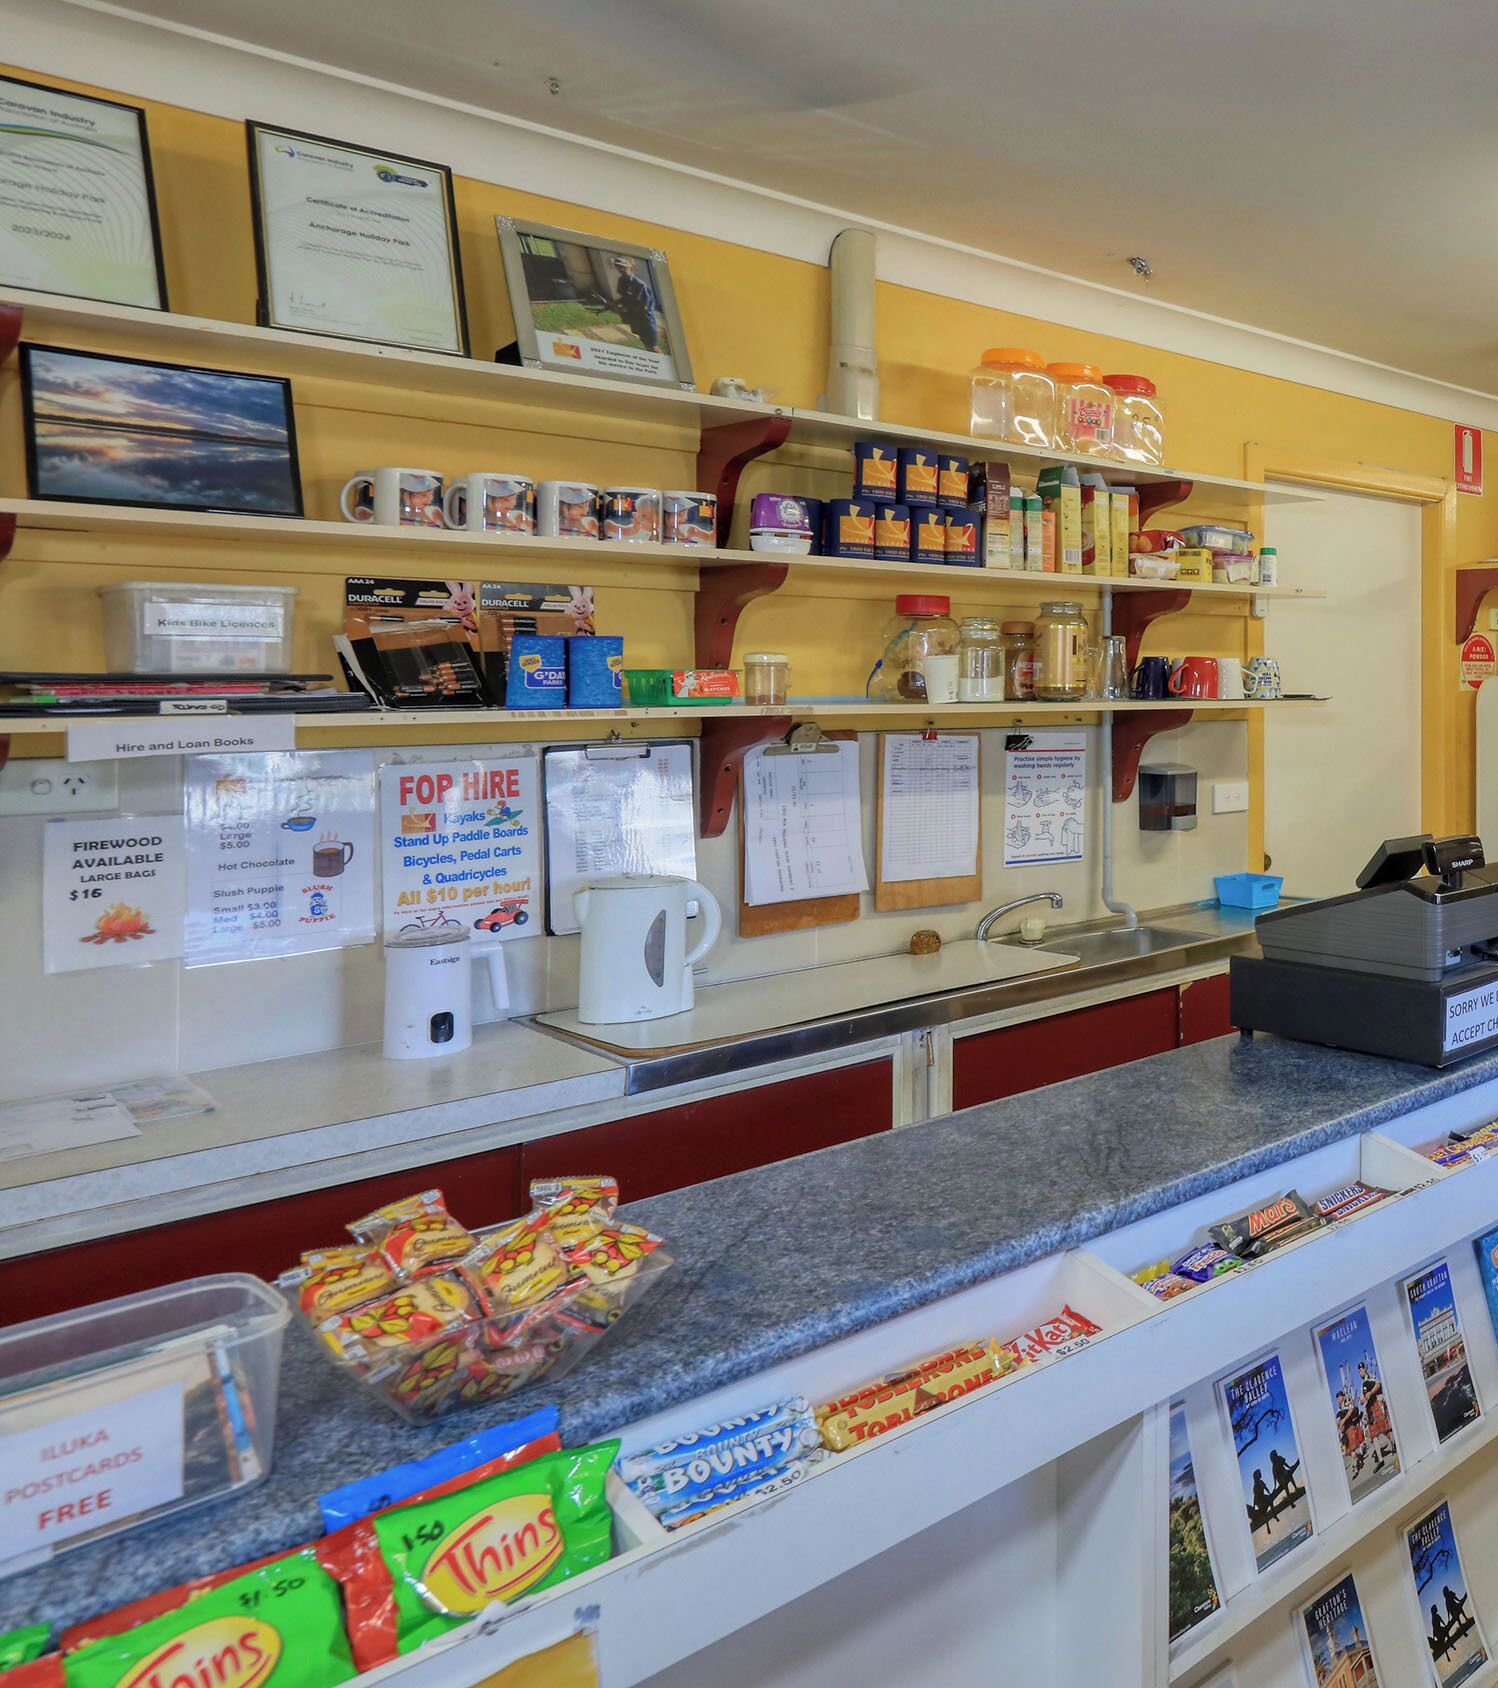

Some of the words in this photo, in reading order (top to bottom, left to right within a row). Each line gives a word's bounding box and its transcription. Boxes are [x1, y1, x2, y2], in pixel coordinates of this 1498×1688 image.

[50, 108, 96, 127] Industry
[306, 196, 348, 210] Certificate
[360, 207, 410, 223] Accreditation
[309, 221, 358, 238] Anchorage
[360, 231, 391, 244] Holiday
[393, 238, 411, 248] Park
[348, 593, 403, 604] DURACELL
[481, 598, 529, 608] DURACELL
[158, 619, 186, 628] Kids
[190, 619, 217, 628] Bike
[220, 620, 275, 629] Licences
[116, 743, 144, 752] Hire
[149, 740, 174, 750] and
[178, 739, 210, 749] Loan
[214, 737, 254, 747] Books
[1036, 755, 1053, 763] simple
[1054, 754, 1074, 763] hygiene
[1075, 754, 1081, 762] by
[463, 769, 520, 801] HIRE
[443, 811, 486, 826] Kayaks
[73, 836, 163, 852] FIREWOOD
[219, 841, 250, 850] $5.00
[394, 835, 429, 848] Stand
[433, 833, 449, 847] Up
[453, 830, 490, 843] Paddle
[493, 826, 529, 839] Boards
[72, 853, 164, 870] AVAILABLE
[218, 862, 238, 871] Hot
[241, 858, 296, 870] Chocolate
[403, 853, 457, 868] Bicycles,
[461, 849, 490, 861] Pedal
[494, 845, 522, 857] Carts
[1451, 858, 1474, 868] SHARP
[80, 872, 122, 883] LARGE
[124, 869, 156, 879] BAGS
[422, 873, 432, 885] &
[435, 866, 507, 884] Quadricycles
[213, 889, 245, 898] Slush
[247, 884, 284, 896] Puppie
[302, 884, 333, 893] SLUSH
[397, 890, 421, 907] All
[426, 886, 458, 904] $10
[463, 884, 489, 902] per
[493, 876, 532, 895] hour!
[1449, 994, 1479, 1018] SORRY
[1480, 991, 1495, 1008] WE
[1451, 1023, 1486, 1046] ACCEPT
[1319, 1185, 1364, 1212] SNICKERS
[1249, 1198, 1297, 1235] Mars
[1426, 1270, 1448, 1289] GRAFTON
[1331, 1320, 1358, 1342] MACLEAN
[1008, 1322, 1068, 1367] KitKat
[1055, 1337, 1091, 1357] $2.50
[1231, 1384, 1246, 1400] THE
[1244, 1365, 1279, 1392] CLARENCE
[1244, 1383, 1269, 1404] VALLEY
[40, 1429, 110, 1462] ILUKA
[662, 1426, 794, 1496] BOUNTY
[4, 1446, 144, 1504] POSTCARDS
[37, 1488, 112, 1531] FREE
[1411, 1530, 1423, 1544] THE
[1421, 1510, 1448, 1537] CLARENCE
[1421, 1527, 1441, 1546] VALLEY
[430, 1507, 560, 1592] Thins
[1314, 1588, 1347, 1621] GRAFTON'S
[1318, 1600, 1348, 1631] HERITAGE
